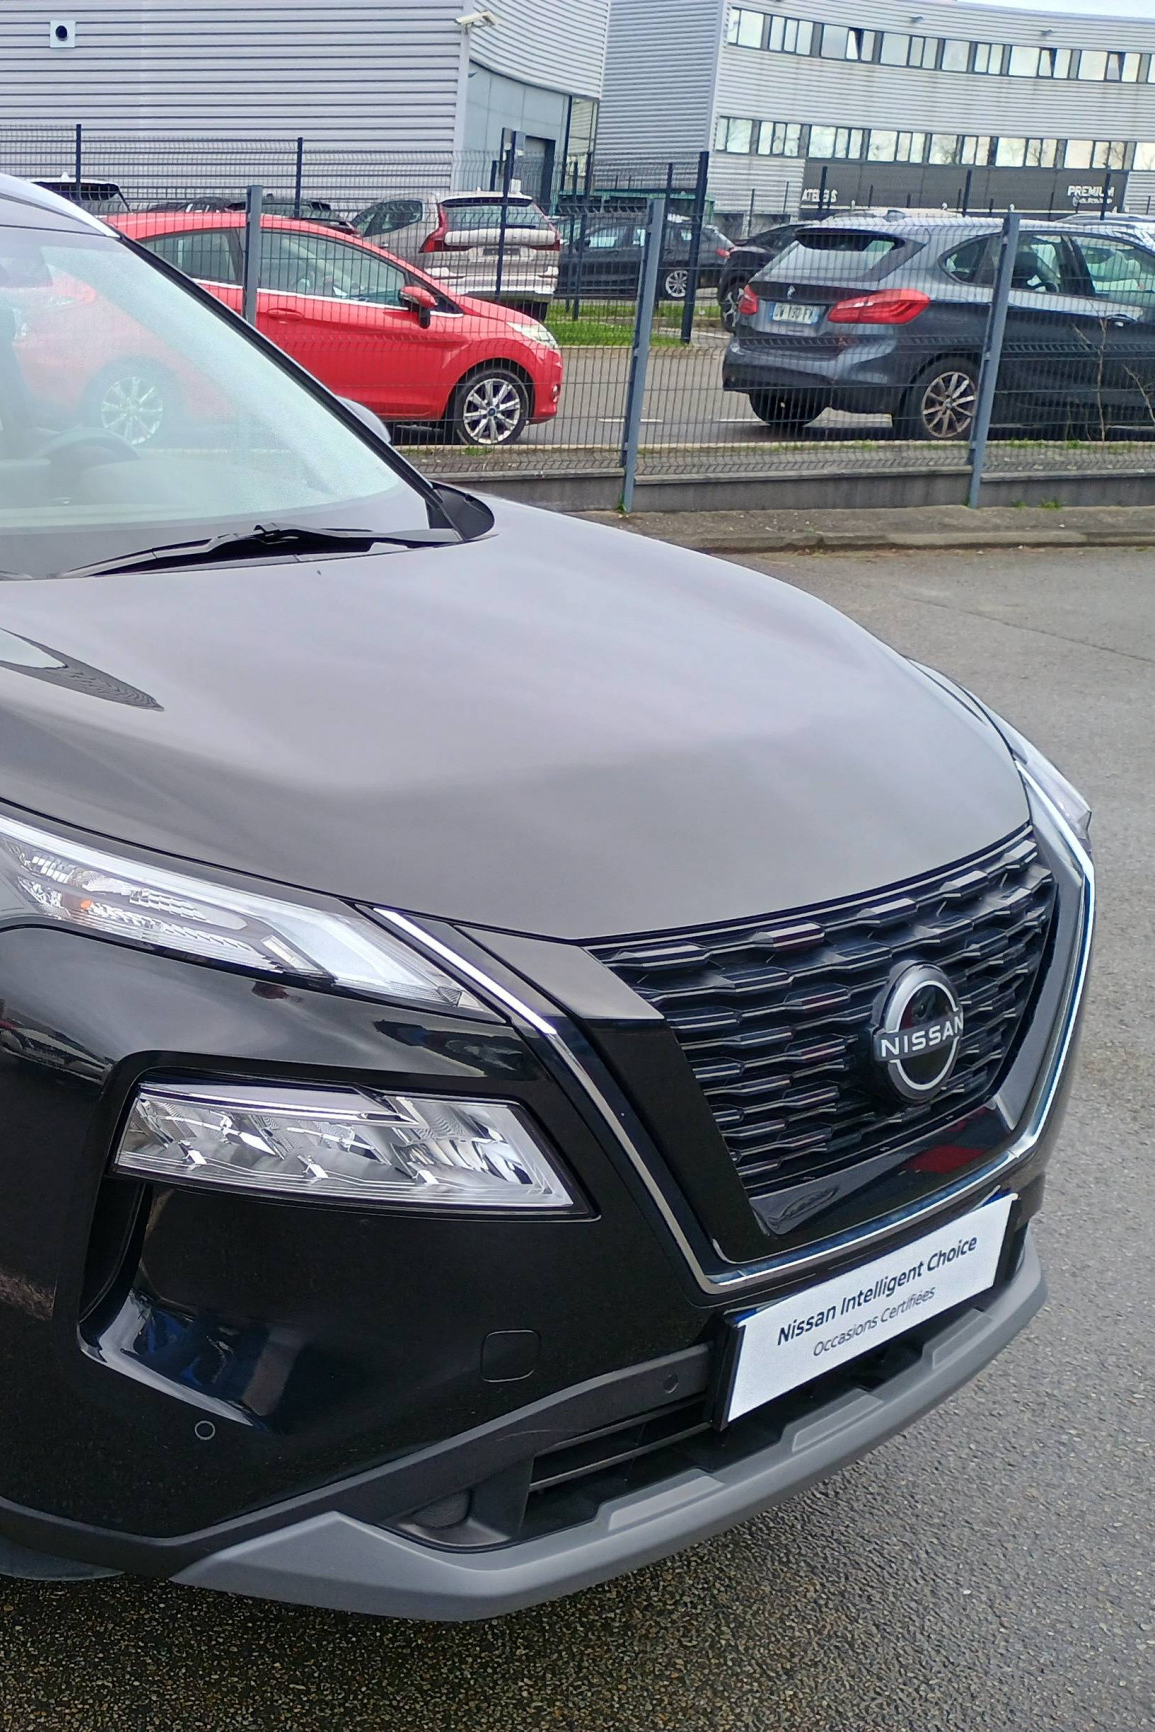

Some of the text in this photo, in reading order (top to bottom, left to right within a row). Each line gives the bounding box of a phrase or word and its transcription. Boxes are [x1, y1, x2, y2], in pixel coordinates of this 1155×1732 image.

[881, 1011, 963, 1057] NISSAN
[777, 1236, 978, 1346] Nissan Intelligent Choice
[813, 1286, 936, 1357] Occasions Certifiées
